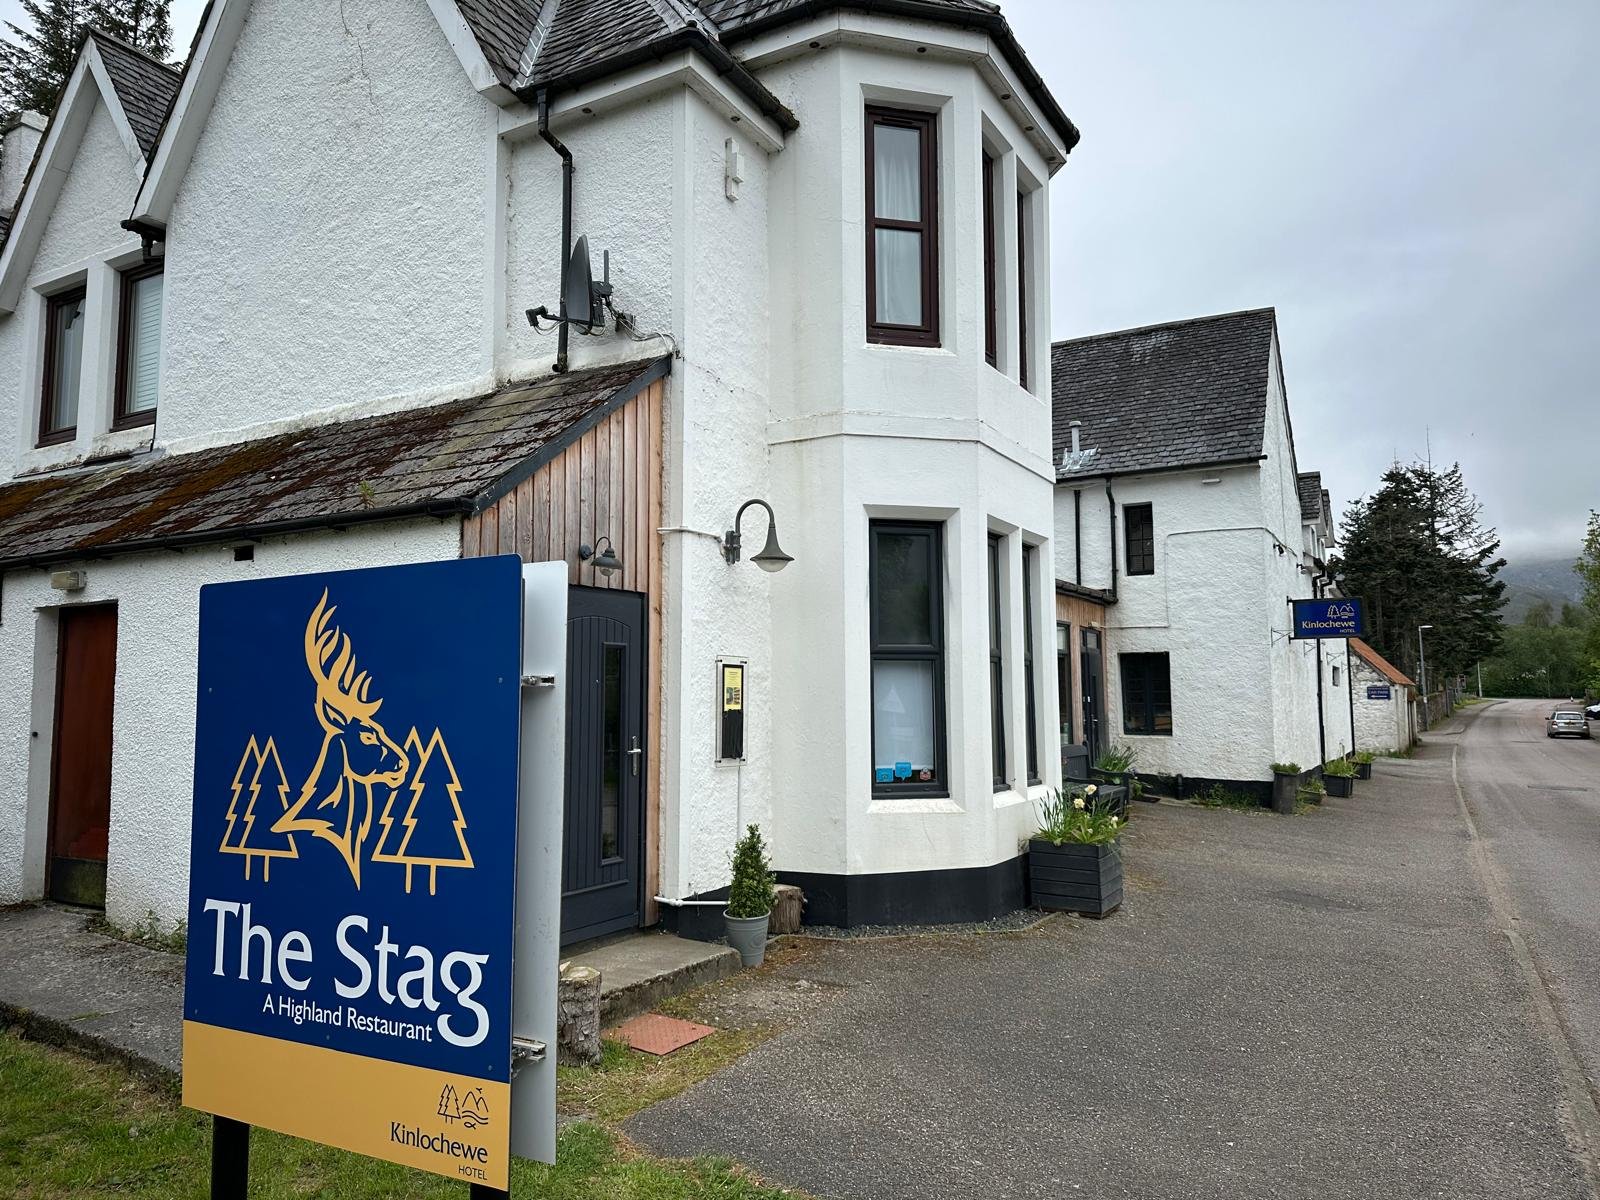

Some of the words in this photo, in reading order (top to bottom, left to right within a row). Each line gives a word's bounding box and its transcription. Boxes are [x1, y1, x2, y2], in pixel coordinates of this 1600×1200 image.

[1302, 620, 1355, 629] Kinlochewe
[203, 898, 313, 991] The
[334, 914, 490, 1047] Stag
[263, 993, 275, 1014] A
[278, 995, 342, 1025] Highland
[347, 1007, 433, 1042] Restaurant
[390, 1121, 488, 1164] Kinlochewe
[458, 1165, 488, 1181] HOTEL
